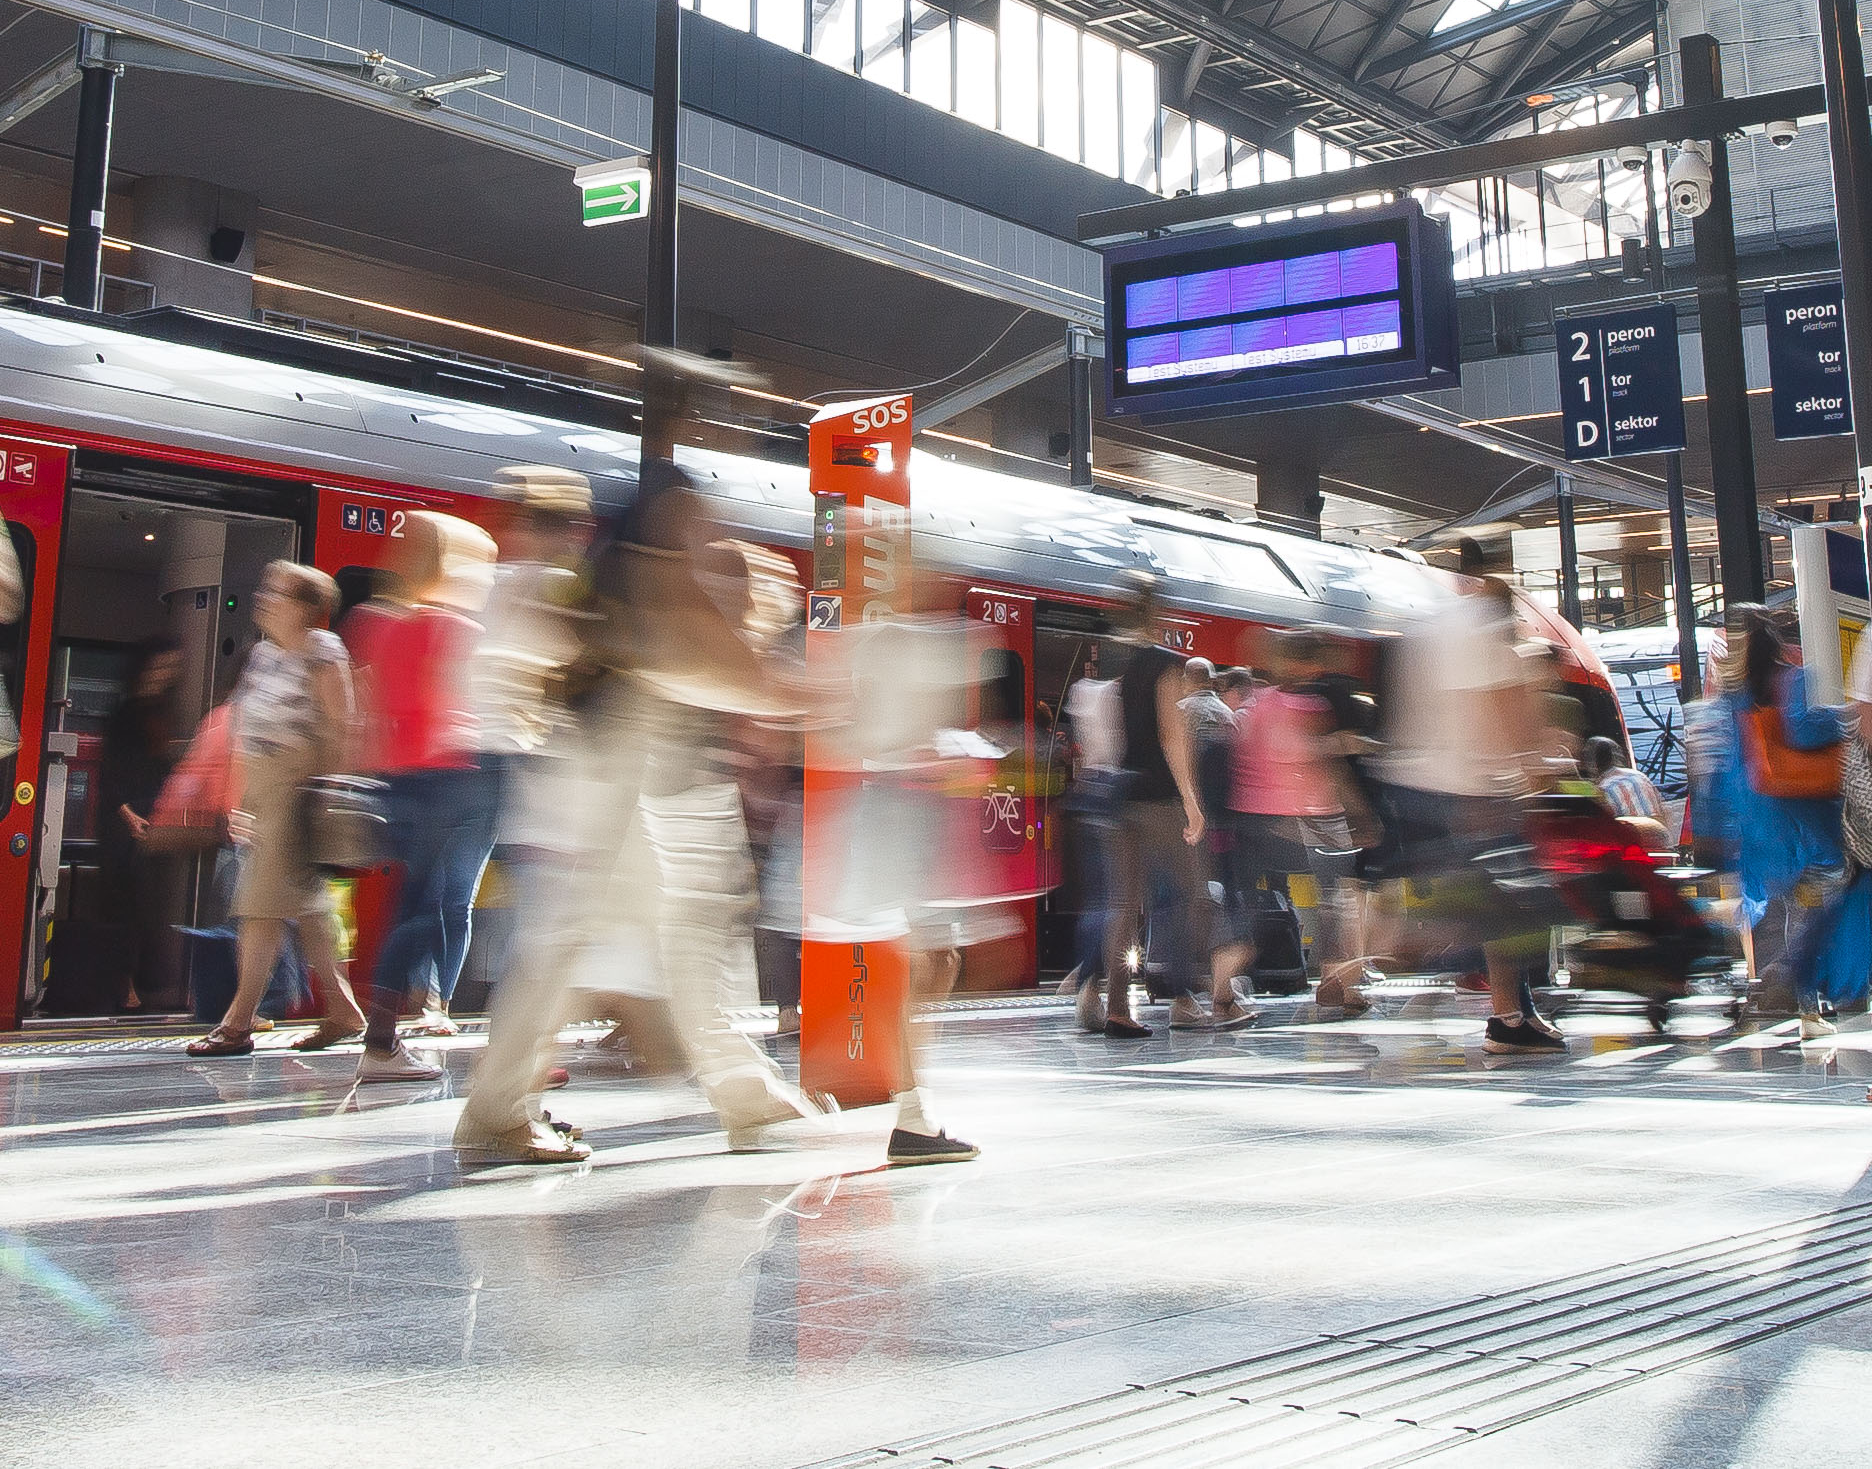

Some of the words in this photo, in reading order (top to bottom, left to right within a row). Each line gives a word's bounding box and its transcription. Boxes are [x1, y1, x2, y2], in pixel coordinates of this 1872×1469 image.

[1785, 303, 1837, 324] peron
[1571, 331, 1591, 362] 2
[1607, 326, 1656, 346] peron
[1817, 350, 1841, 364] tor
[1578, 376, 1591, 403] 1
[1610, 374, 1633, 387] tor
[852, 399, 908, 434] SOS
[1795, 396, 1843, 413] sektor
[1576, 420, 1599, 448] D
[1614, 415, 1659, 432] sektor
[389, 510, 407, 539] 2
[981, 600, 993, 623] 2
[1185, 630, 1194, 651] 2
